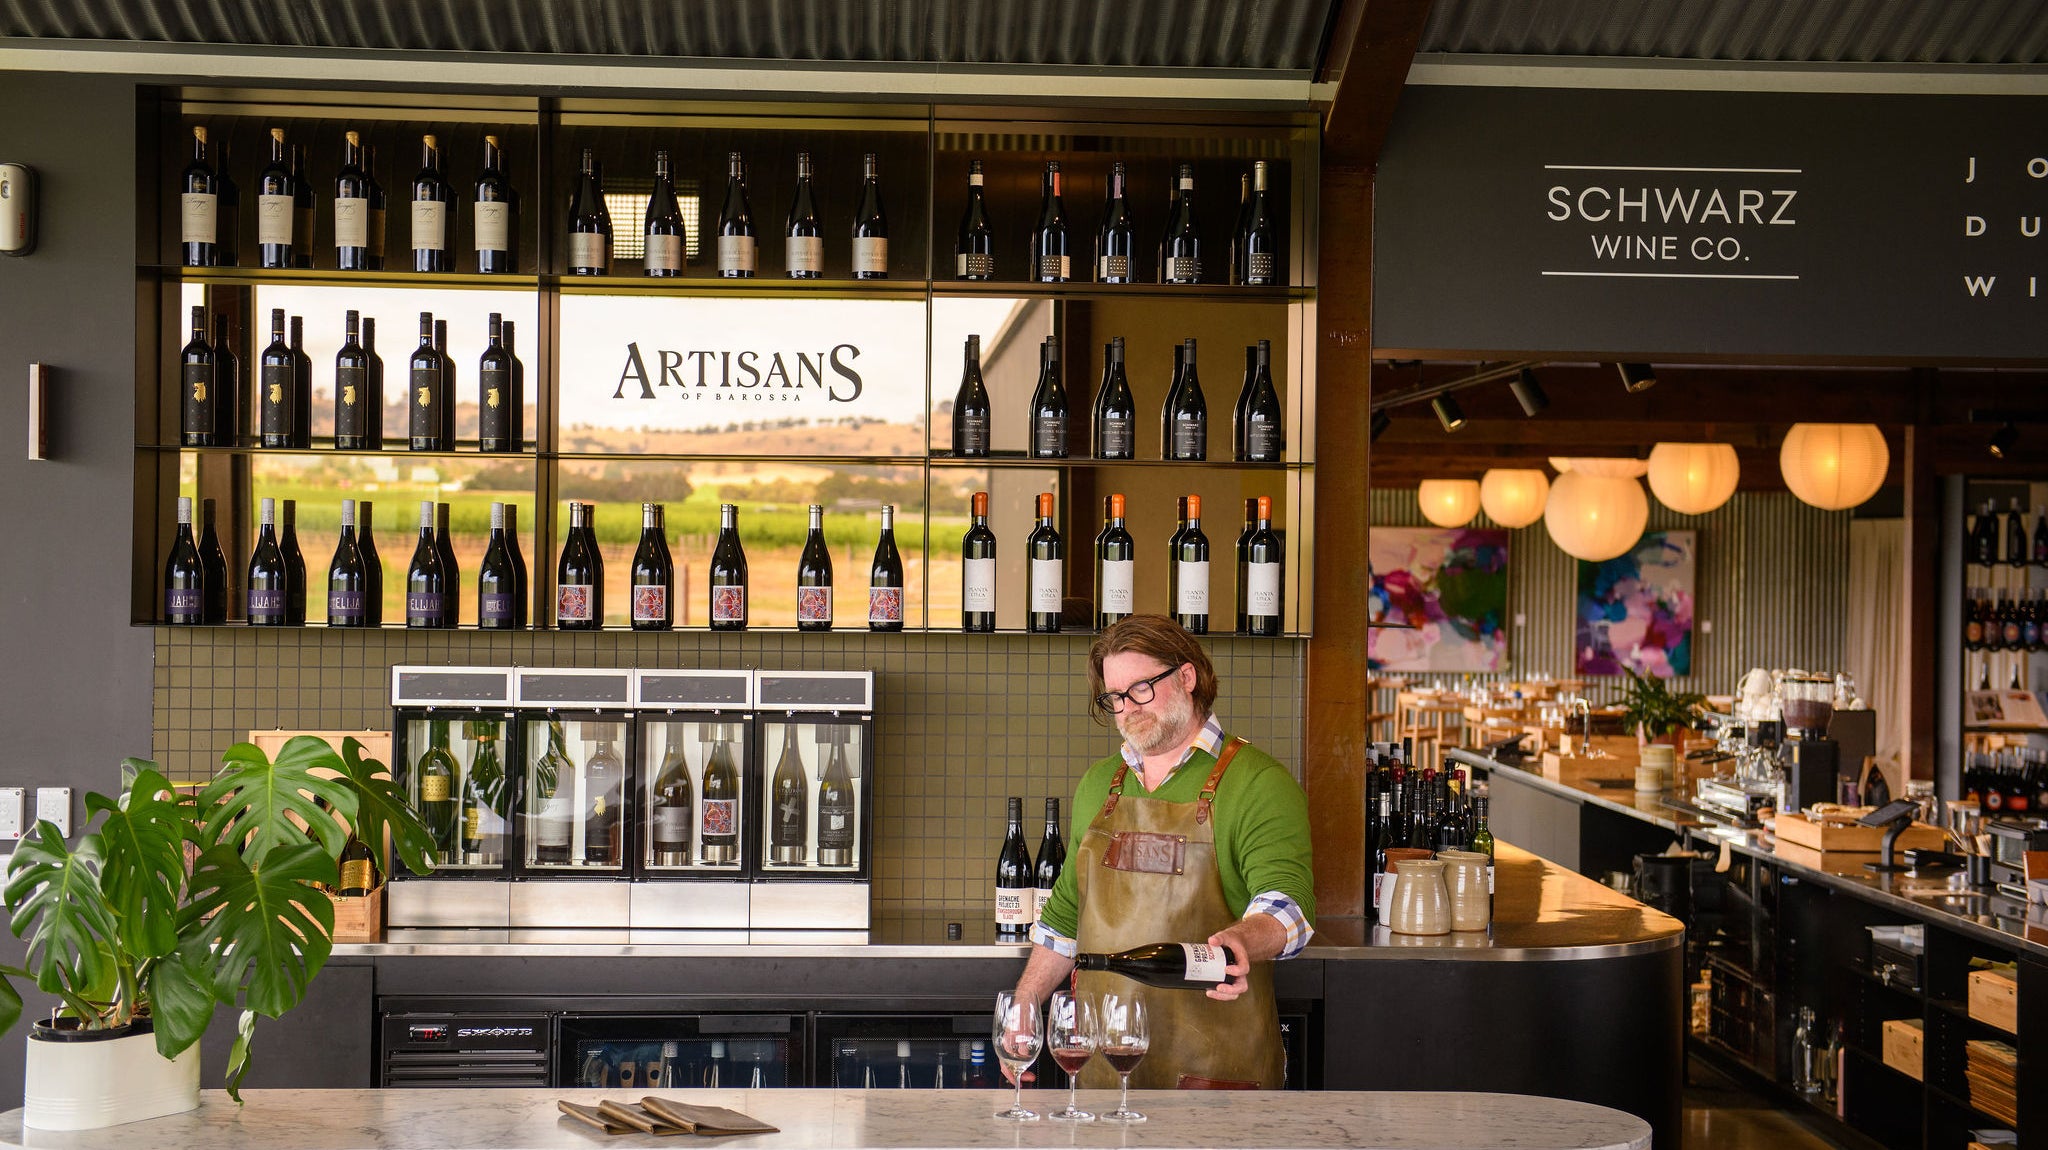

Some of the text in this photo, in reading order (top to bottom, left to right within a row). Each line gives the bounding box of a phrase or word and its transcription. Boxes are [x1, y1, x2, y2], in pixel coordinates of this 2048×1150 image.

[1547, 186, 1798, 225] SCHWARZ
[1966, 215, 2041, 237] DU
[1591, 234, 1750, 261] WINE CO.
[1964, 276, 2037, 297] WI
[612, 341, 863, 403] ARTISANS
[681, 393, 801, 402] OF BAROSSA
[998, 894, 1020, 903] GRENACHE
[457, 1027, 533, 1037] SKOPE
